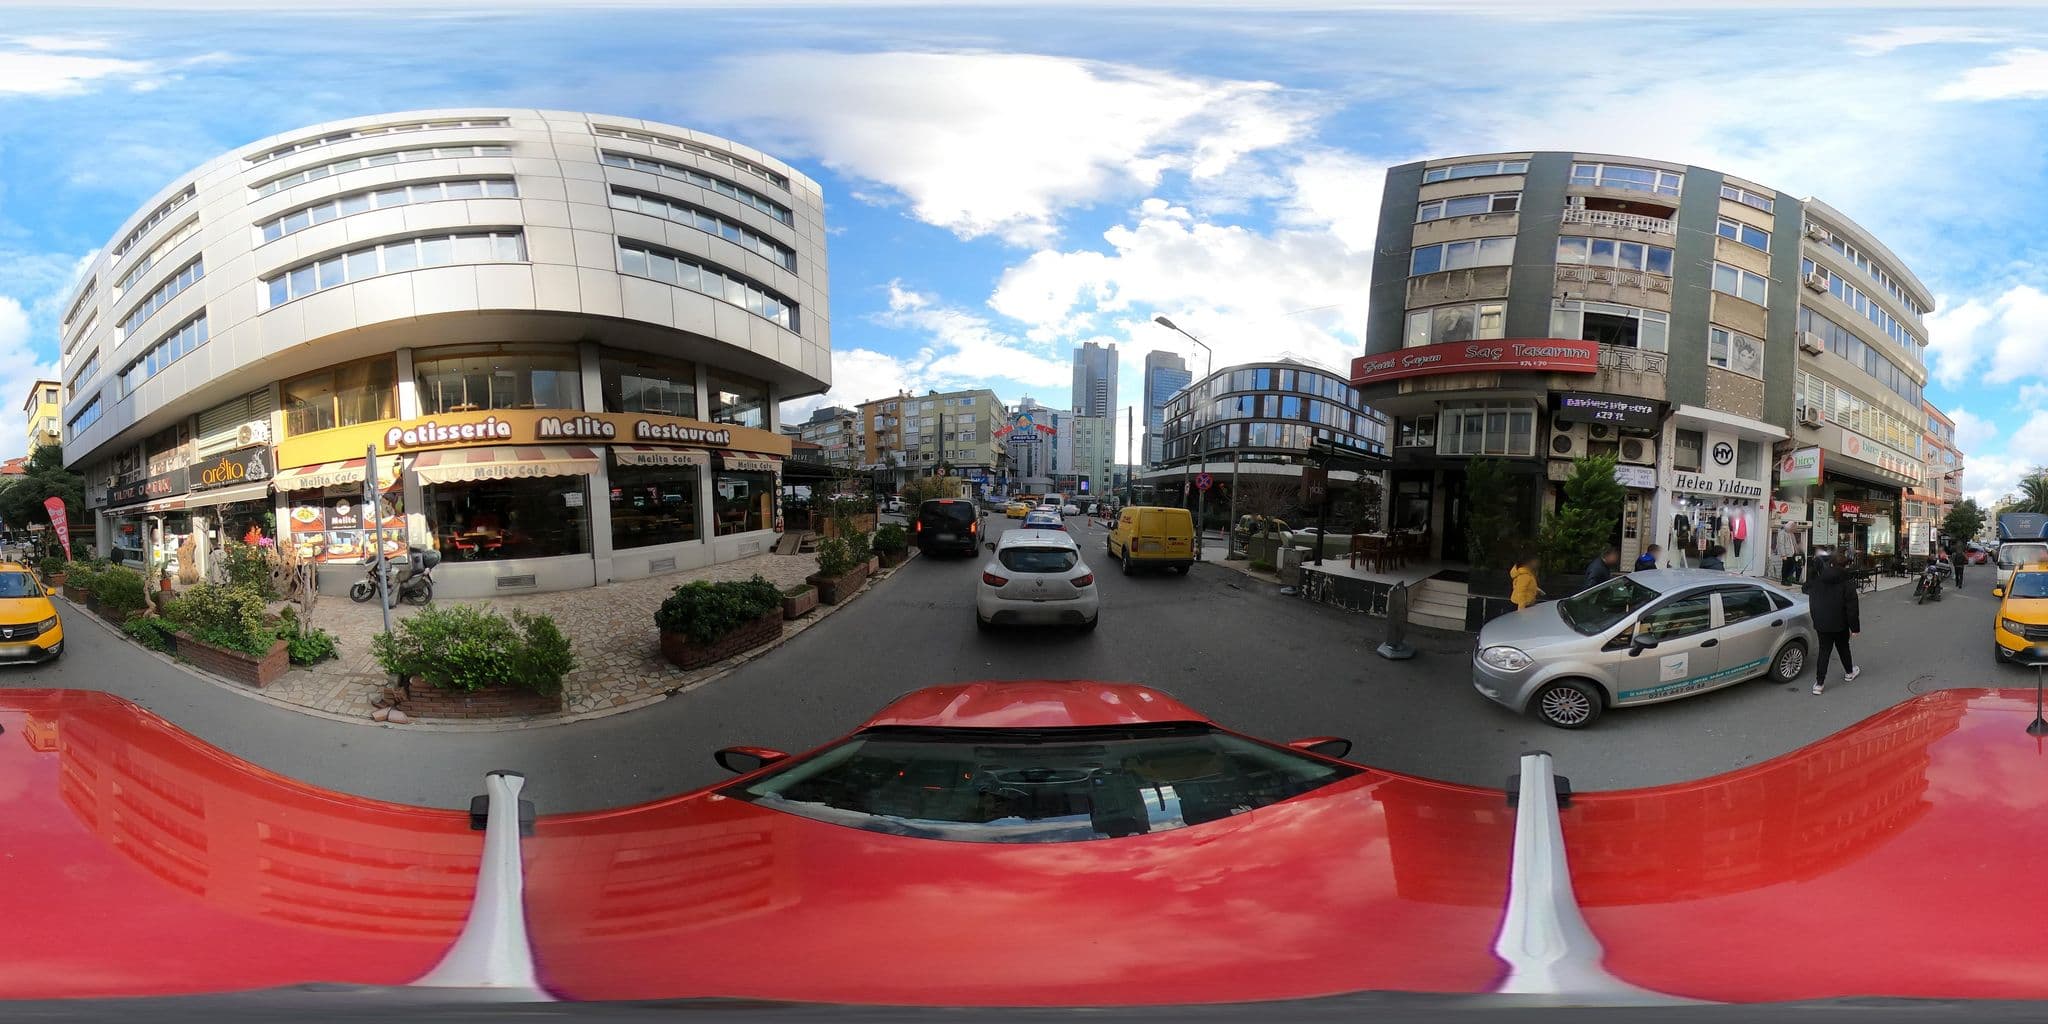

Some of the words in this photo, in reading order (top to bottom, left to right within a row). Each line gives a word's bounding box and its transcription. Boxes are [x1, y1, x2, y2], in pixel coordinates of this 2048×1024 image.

[1464, 343, 1504, 361] Saç
[387, 416, 511, 447] Patisseria
[539, 416, 615, 438] Melita
[636, 420, 730, 445] Restaurant
[1715, 447, 1733, 460] HY
[1676, 474, 1713, 490] Helen
[1718, 478, 1762, 496] Yıldırım
